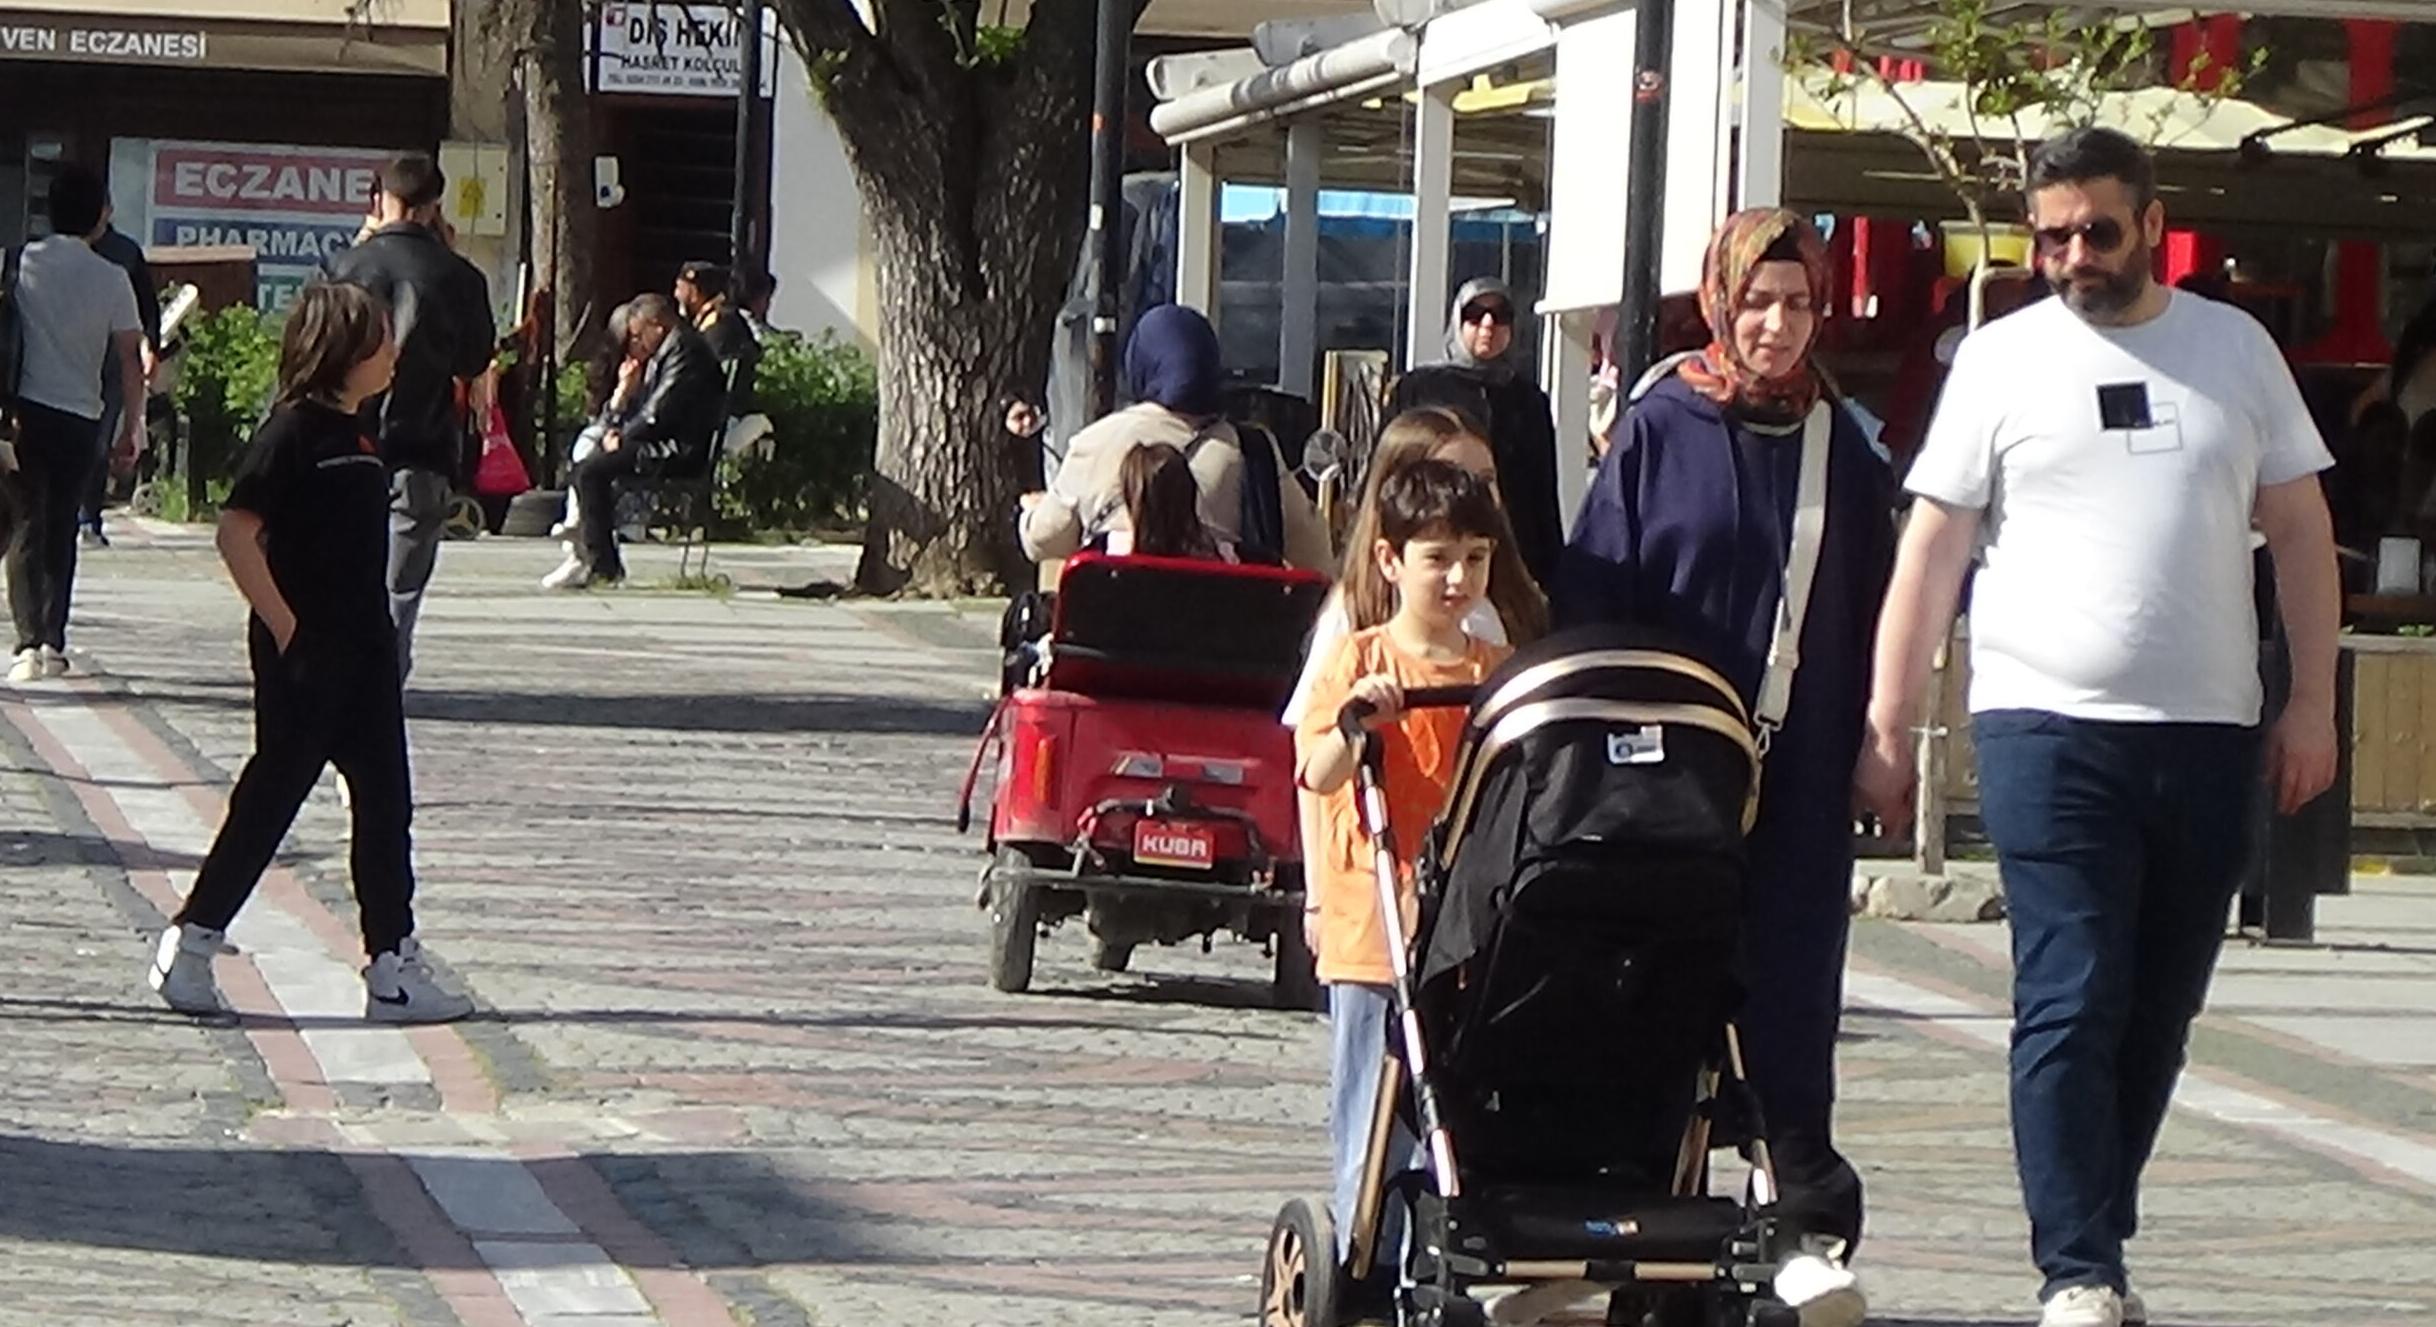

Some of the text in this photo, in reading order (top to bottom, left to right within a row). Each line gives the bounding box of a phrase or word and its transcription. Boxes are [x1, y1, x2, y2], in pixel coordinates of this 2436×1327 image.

[1, 27, 56, 51] VEN
[174, 161, 374, 203] ECZANE
[1142, 834, 1207, 857] KUBA
